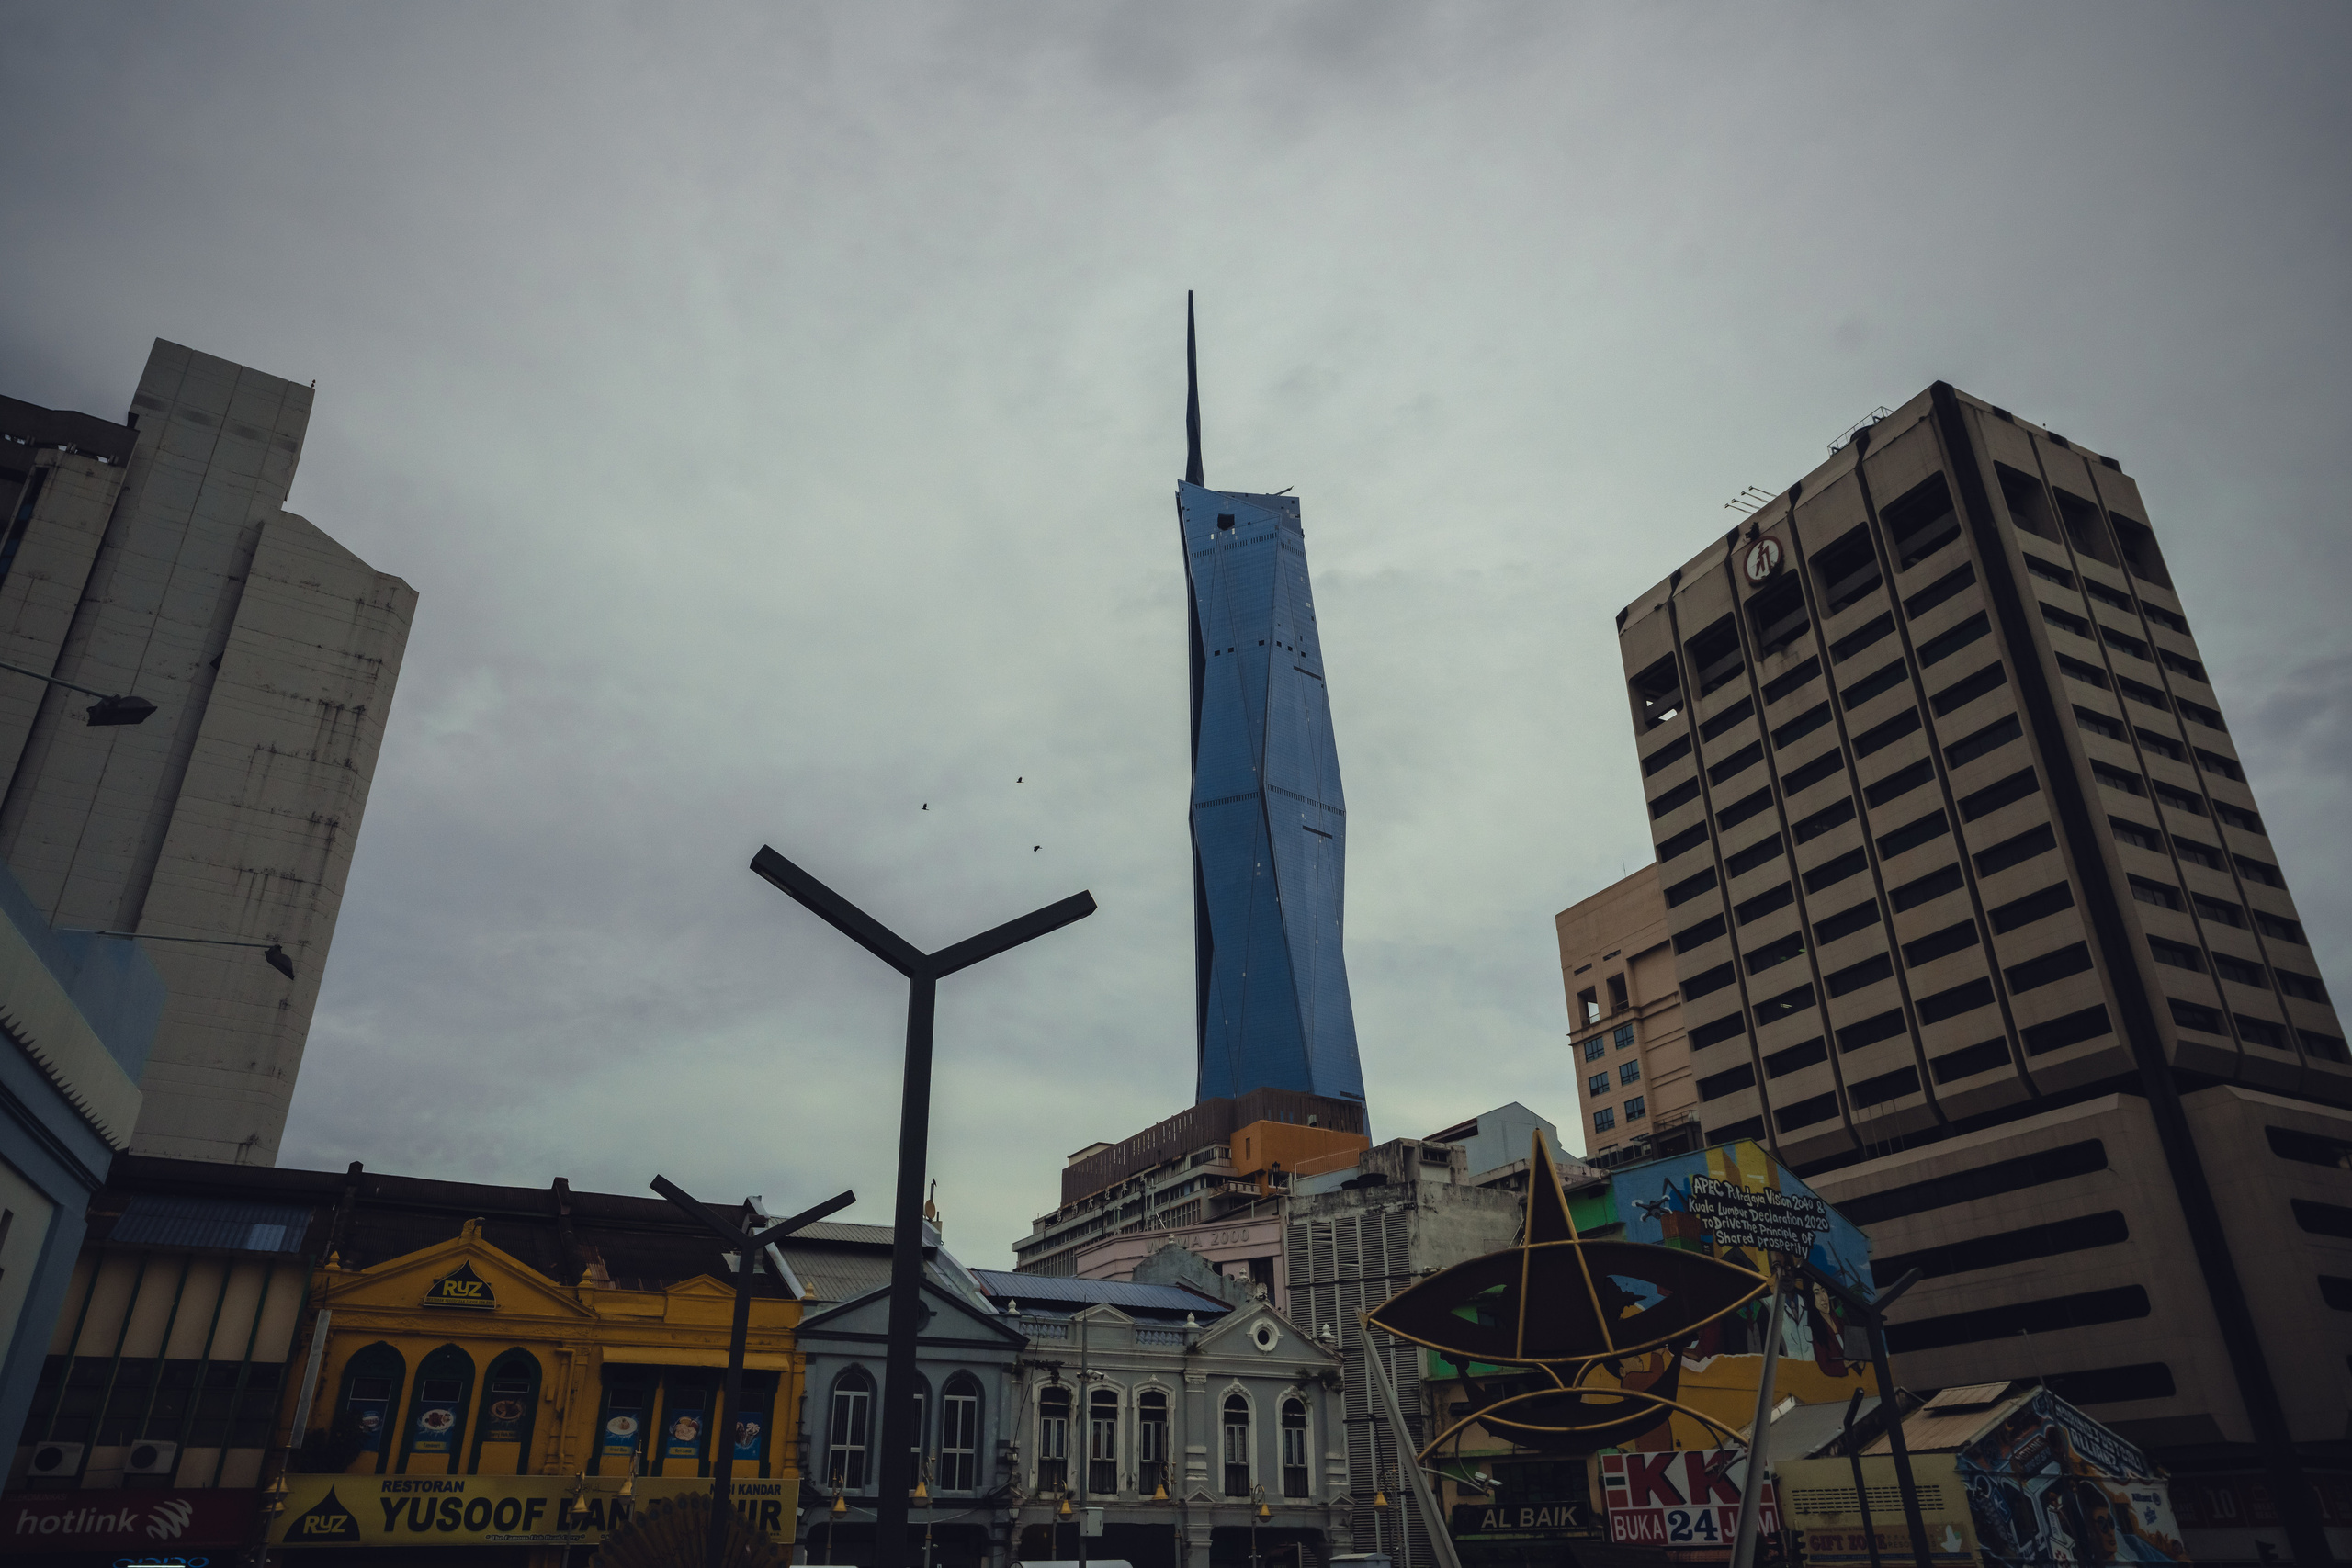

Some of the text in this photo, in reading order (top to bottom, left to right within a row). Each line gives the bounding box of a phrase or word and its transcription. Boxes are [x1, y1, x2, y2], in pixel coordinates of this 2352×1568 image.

[1693, 1177, 1724, 1197] APEC
[1792, 1196, 1814, 1211] 2040
[1816, 1201, 1826, 1214] &
[1689, 1198, 1829, 1231] Kuala Lumpur Declaration 2020
[1146, 1229, 1250, 1253] WIMA 2000
[1715, 1230, 1809, 1260] Shared prosperity
[1758, 1224, 1798, 1242] Principle
[381, 1480, 465, 1493] RESTORAN
[709, 1483, 781, 1495] NI KANDAR
[1625, 1450, 1742, 1506] KK
[15, 1507, 139, 1534] hotlink
[379, 1497, 548, 1532] YUSOOF
[1481, 1506, 1577, 1529] AL BAIK
[1613, 1509, 1776, 1542] BUKA 24 JM
[1809, 1534, 1888, 1551] GIFT ZOE
